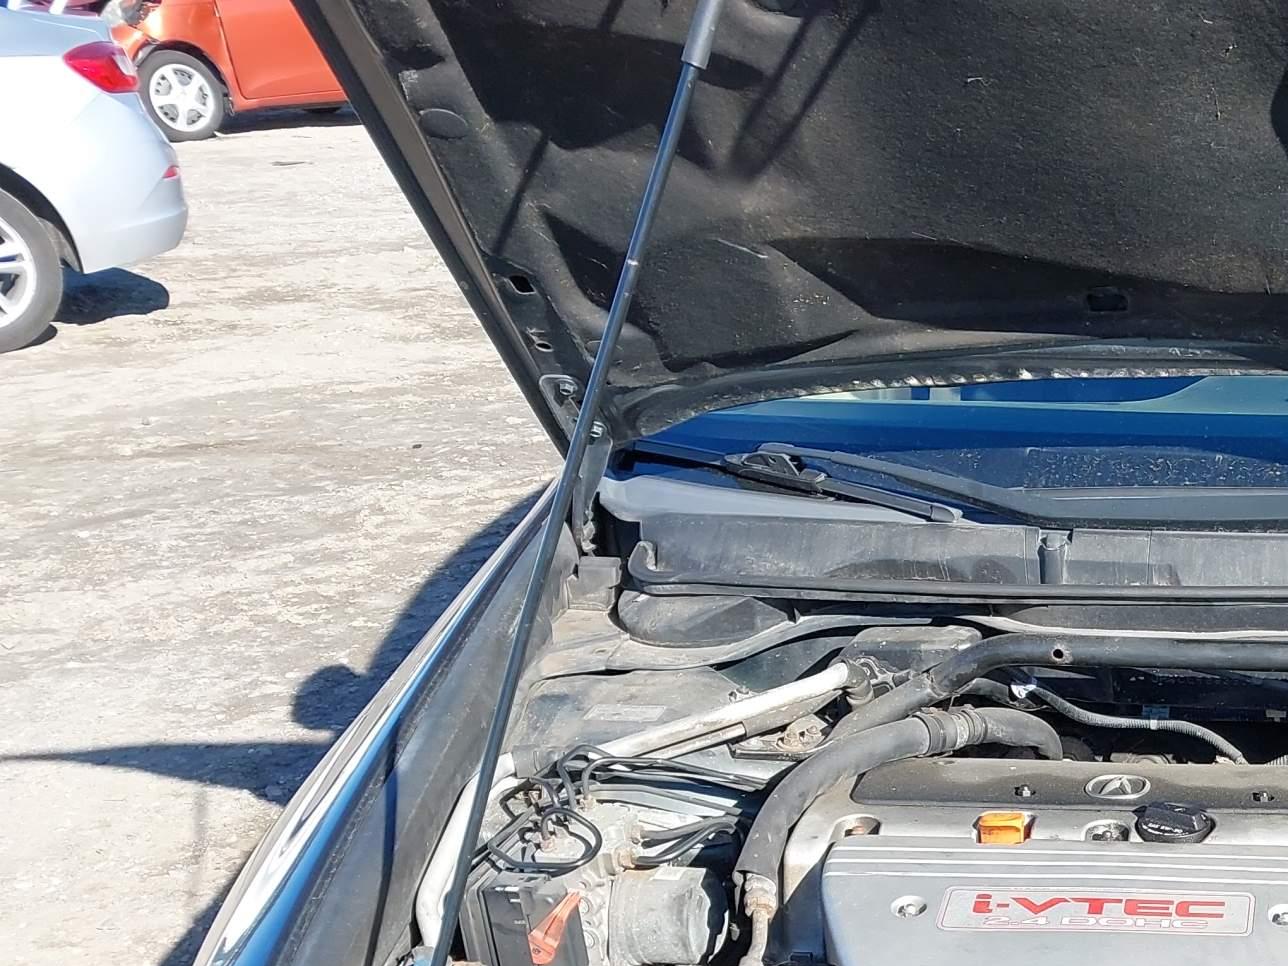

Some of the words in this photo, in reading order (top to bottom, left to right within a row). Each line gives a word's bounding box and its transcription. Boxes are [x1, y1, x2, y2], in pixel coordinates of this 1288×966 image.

[972, 893, 1226, 919] i-VTEC
[983, 916, 1050, 926] 2.4
[1060, 916, 1209, 929] DOHC
